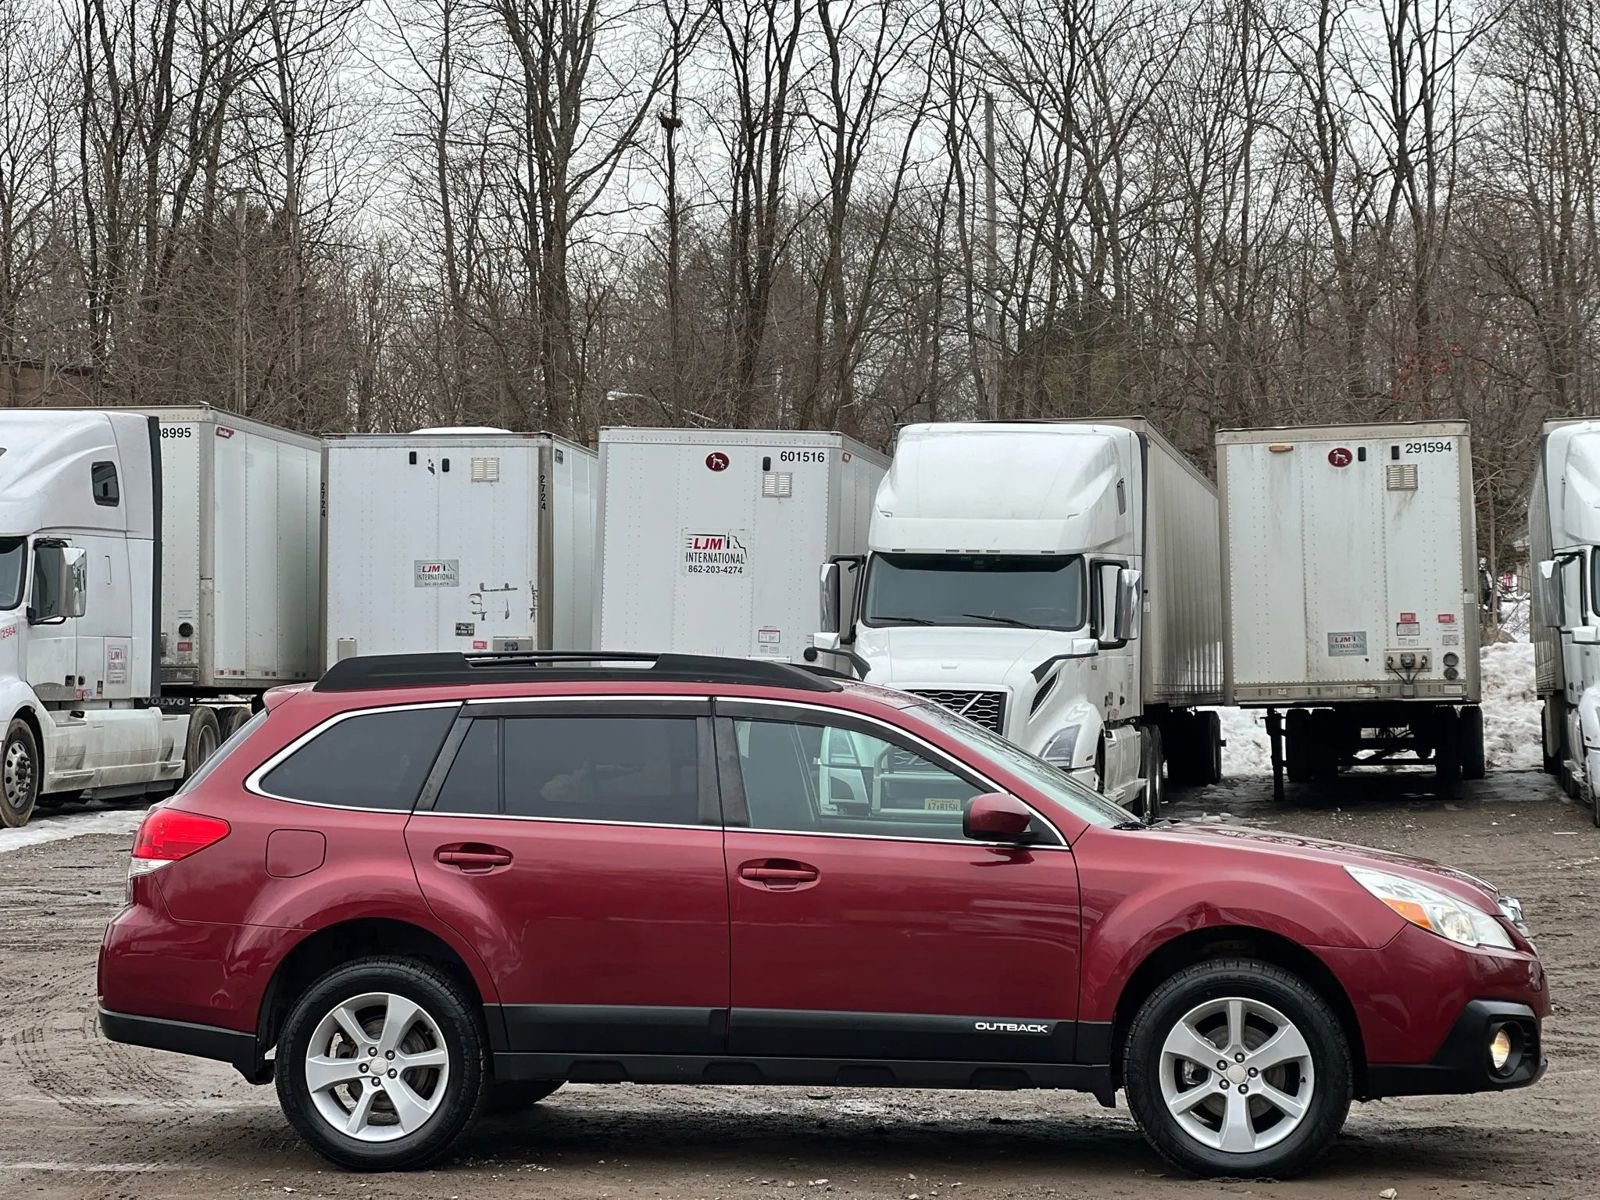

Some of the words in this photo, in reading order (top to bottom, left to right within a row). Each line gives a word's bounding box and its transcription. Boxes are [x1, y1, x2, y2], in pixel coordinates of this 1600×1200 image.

[159, 427, 191, 439] 8995
[1405, 441, 1452, 453] 291594
[780, 451, 825, 463] 601516
[693, 537, 722, 550] LJM
[685, 552, 745, 564] INTERNATIONAL
[688, 564, 743, 574] 862-203-4274
[143, 698, 186, 706] VOLVO
[975, 1022, 1048, 1033] OUTBACK
